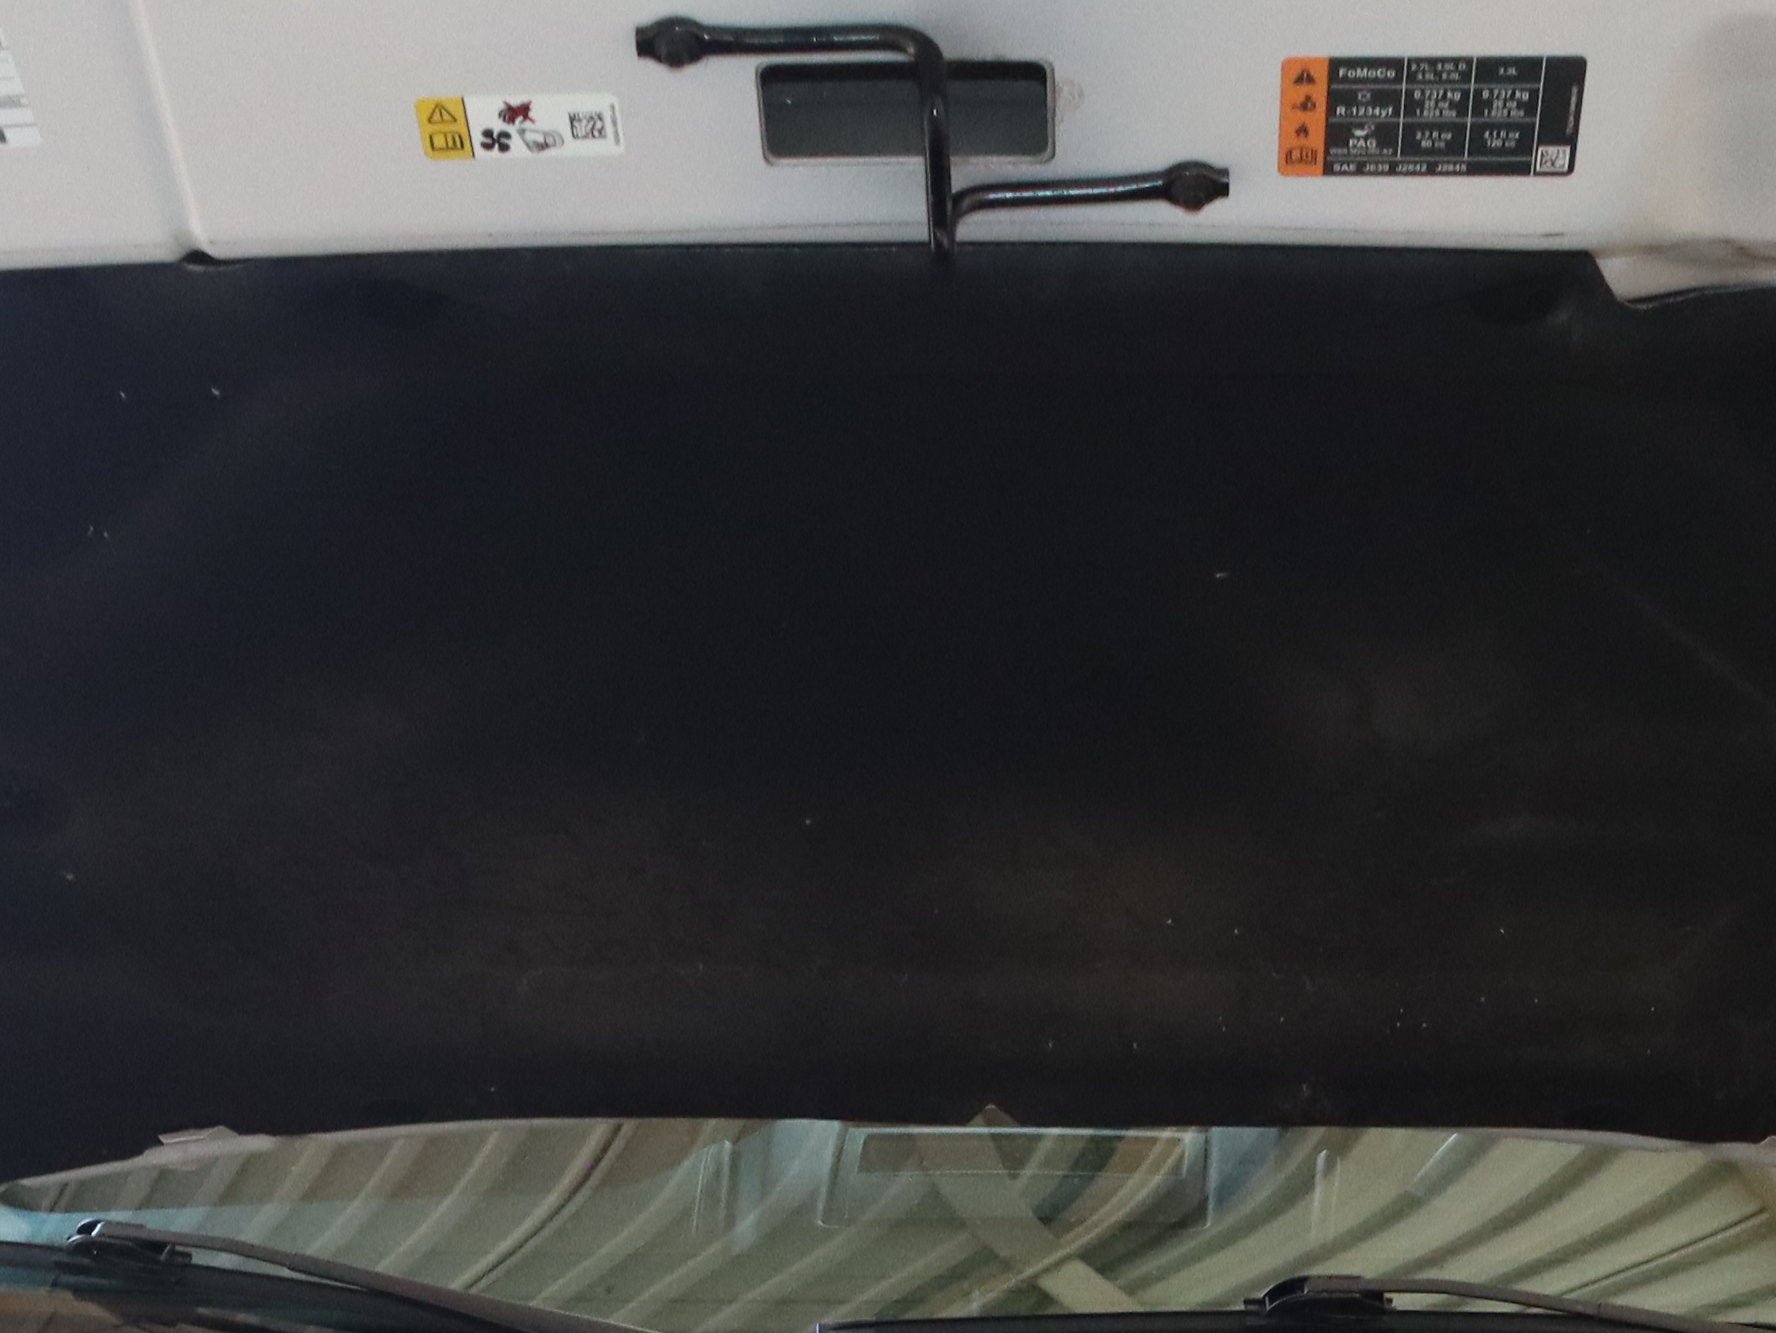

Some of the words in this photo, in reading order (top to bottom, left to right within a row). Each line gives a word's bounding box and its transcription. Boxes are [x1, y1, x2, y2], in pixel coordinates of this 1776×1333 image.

[1338, 67, 1396, 79] FoMoCo
[1414, 89, 1443, 100] 0.737
[1447, 90, 1462, 101] kg
[1482, 89, 1512, 100] 0.737
[1515, 90, 1530, 101] kg
[1336, 106, 1394, 118] R-1234yf
[1349, 139, 1377, 148] PAG
[1333, 163, 1357, 172] SAE
